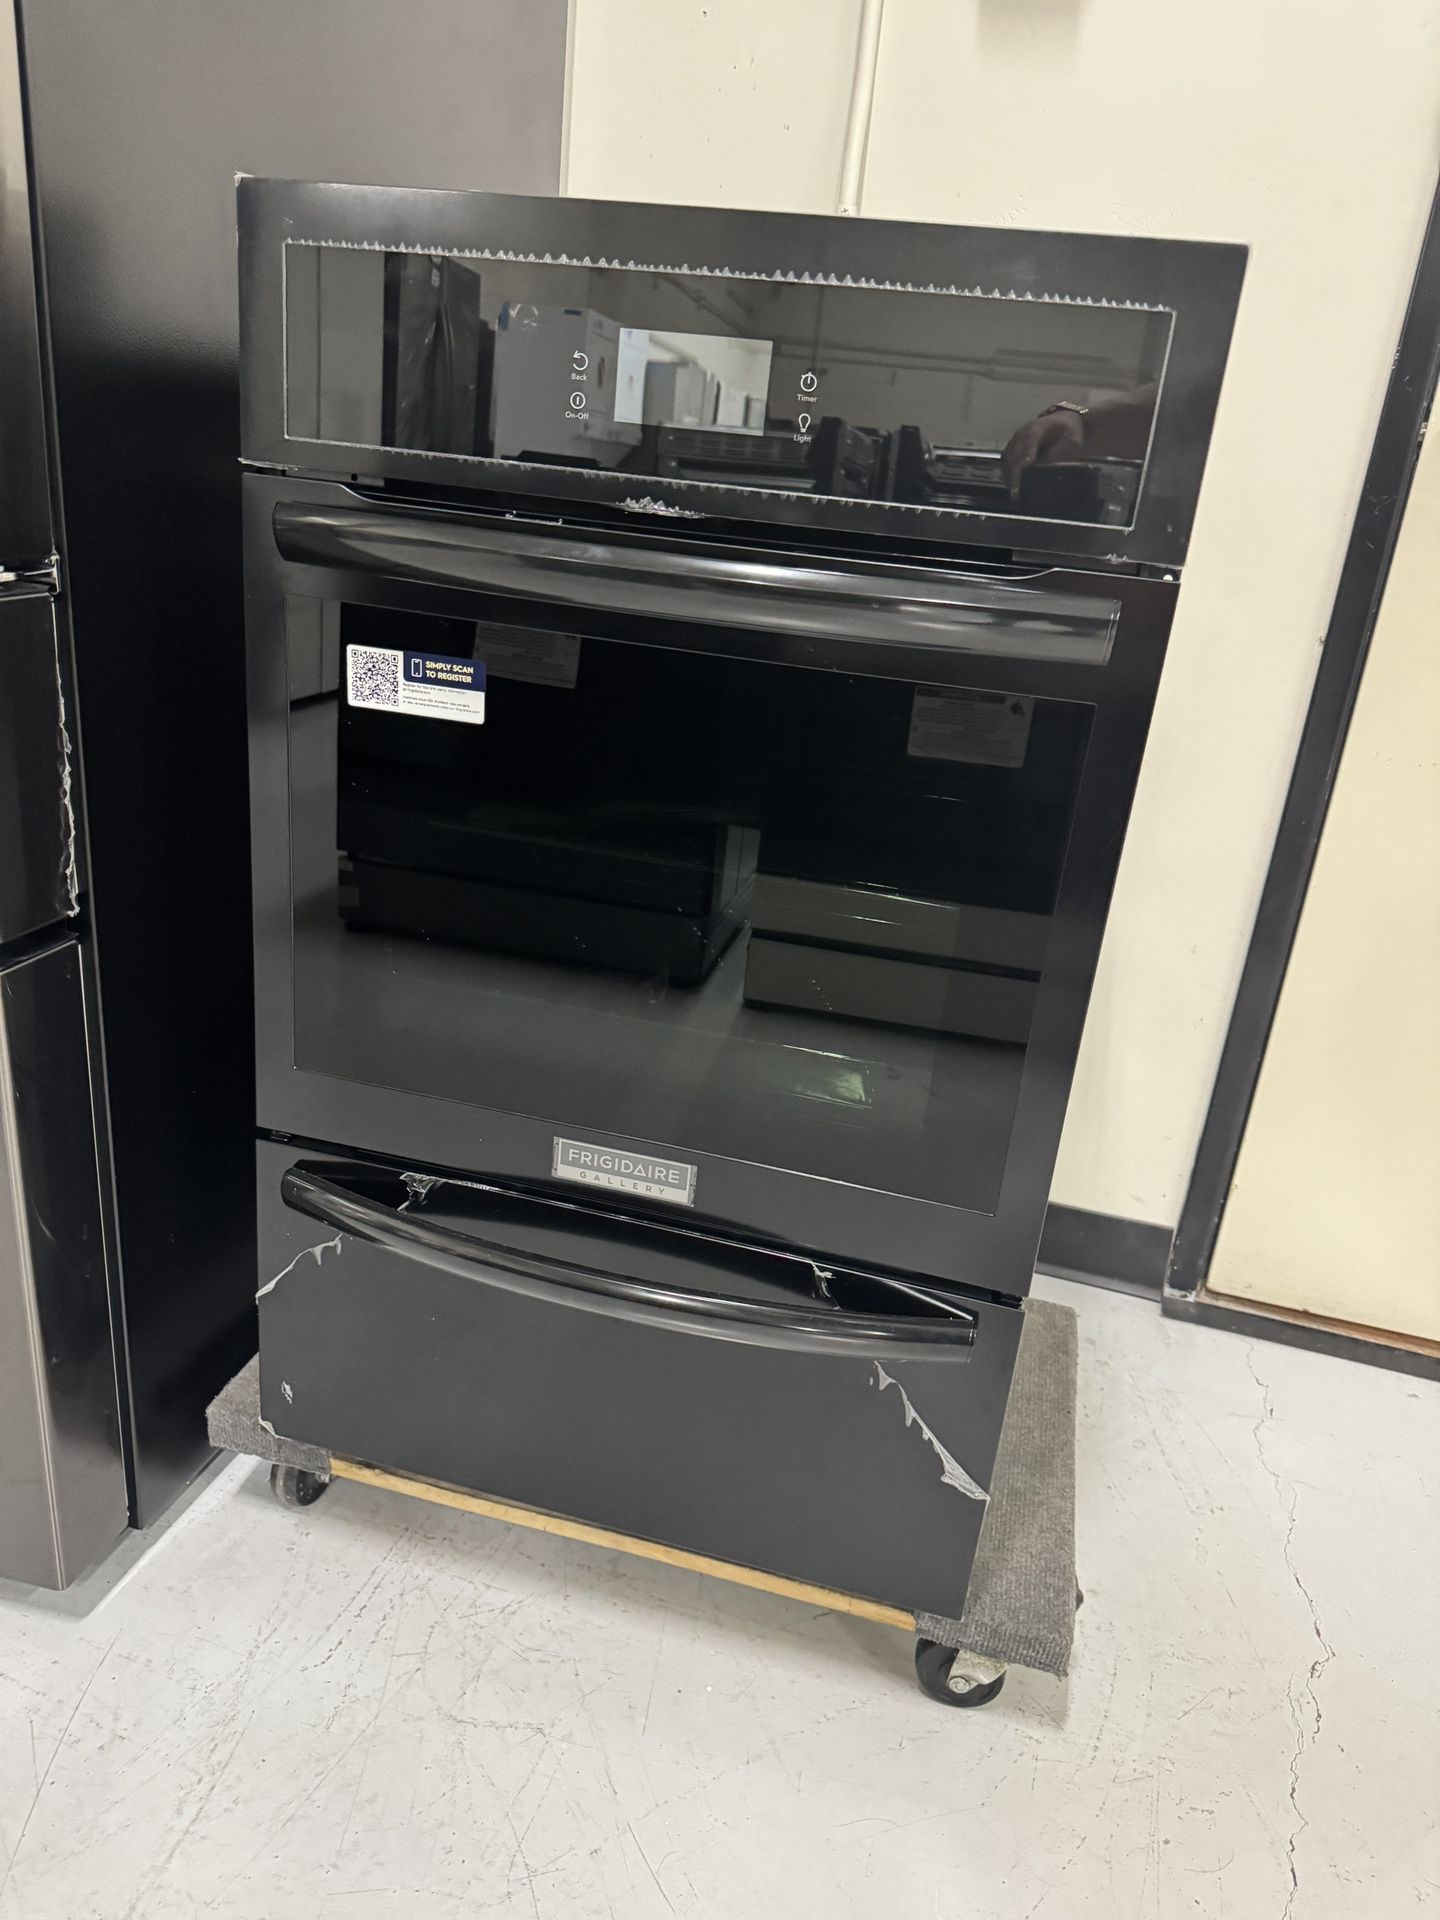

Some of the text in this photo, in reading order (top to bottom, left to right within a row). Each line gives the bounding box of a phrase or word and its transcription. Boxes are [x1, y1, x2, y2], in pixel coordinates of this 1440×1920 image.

[571, 373, 587, 381] Back
[797, 394, 817, 402] Timer
[565, 411, 589, 420] On-Off
[793, 434, 811, 443] Light
[425, 661, 474, 675] SIMPLY SCAN
[425, 670, 472, 683] TO REGISTER
[568, 1149, 681, 1184] FRIGIDAIRE
[579, 1171, 666, 1196] GALLERY
